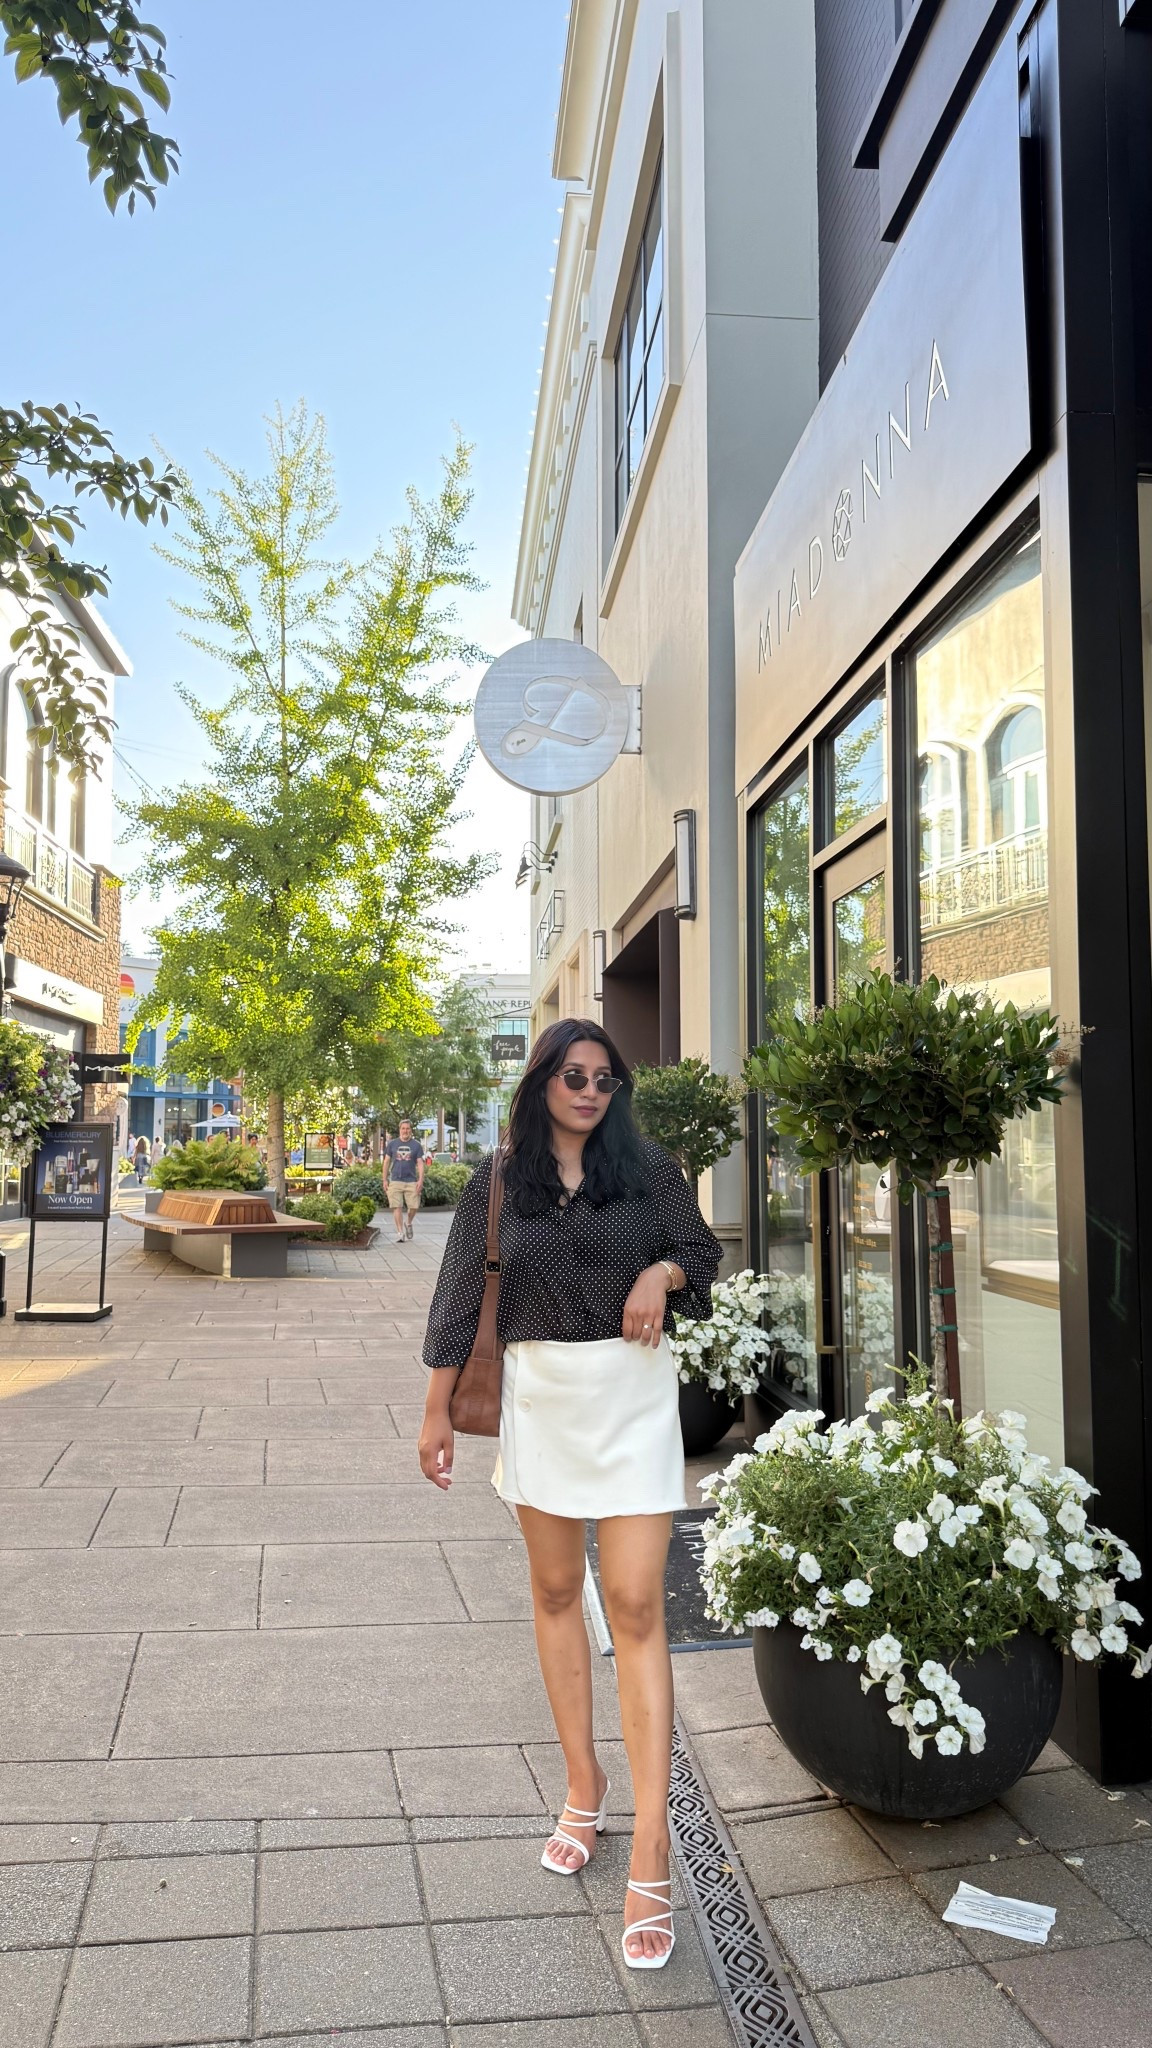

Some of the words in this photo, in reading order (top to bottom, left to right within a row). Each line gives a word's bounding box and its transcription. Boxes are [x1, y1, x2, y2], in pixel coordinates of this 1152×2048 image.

[758, 338, 950, 674] MIADONNA
[48, 1194, 68, 1204] Now
[69, 1194, 93, 1206] Open
